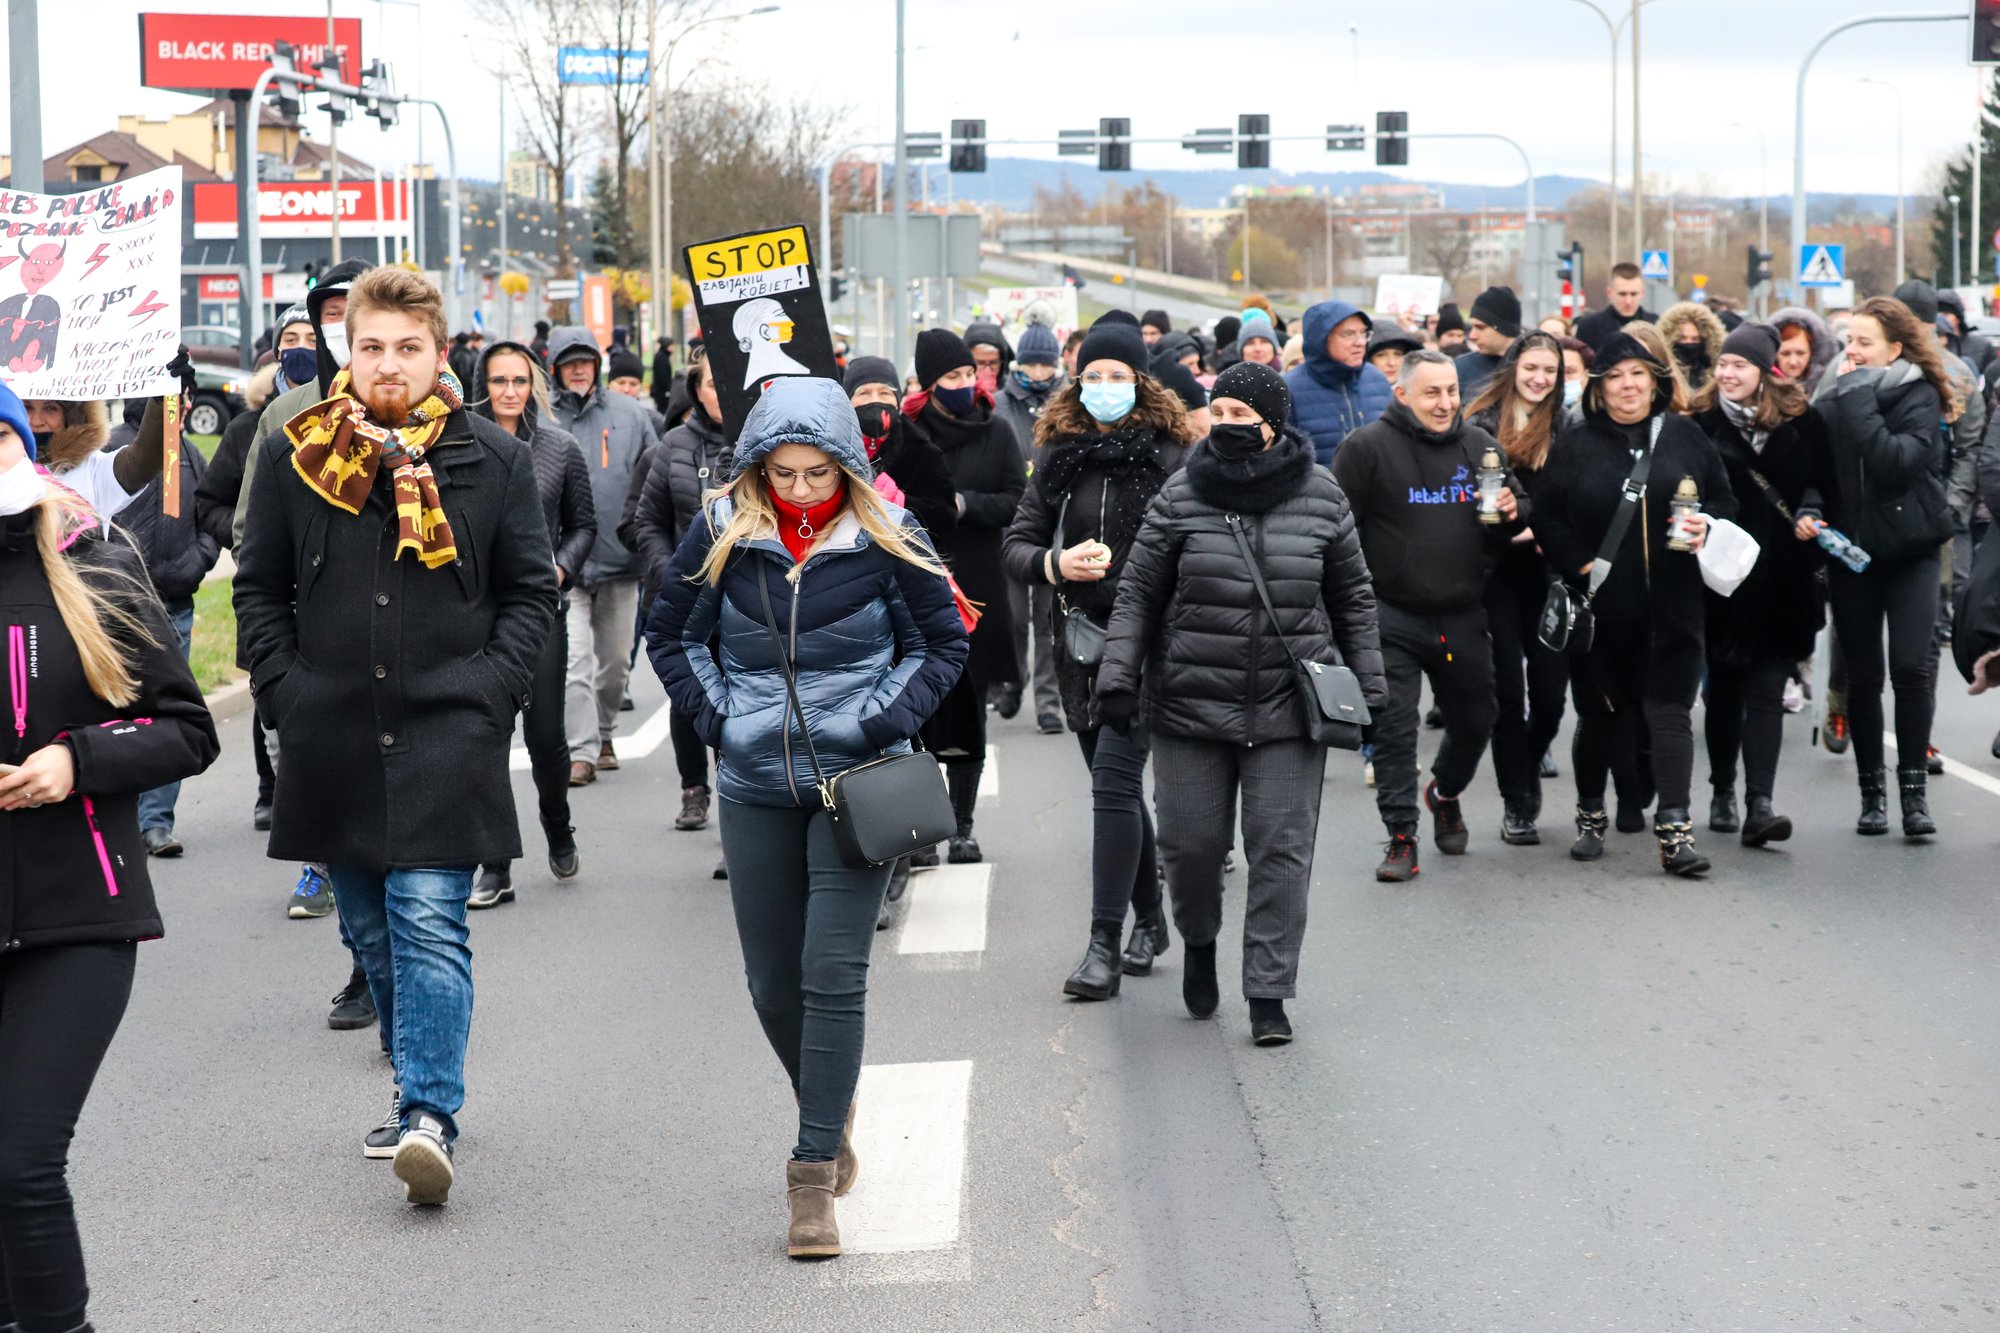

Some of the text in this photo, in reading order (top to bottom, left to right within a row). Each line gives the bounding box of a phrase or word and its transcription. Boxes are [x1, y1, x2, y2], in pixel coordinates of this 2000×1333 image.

[158, 40, 226, 61] BLACK
[232, 42, 275, 62] RED
[46, 185, 123, 219] POLSKE
[706, 238, 795, 278] STOP
[703, 274, 763, 293] ZABIJANIU
[738, 278, 793, 299] KOBIET
[99, 284, 137, 313] JEST
[1408, 486, 1447, 504] Jebać
